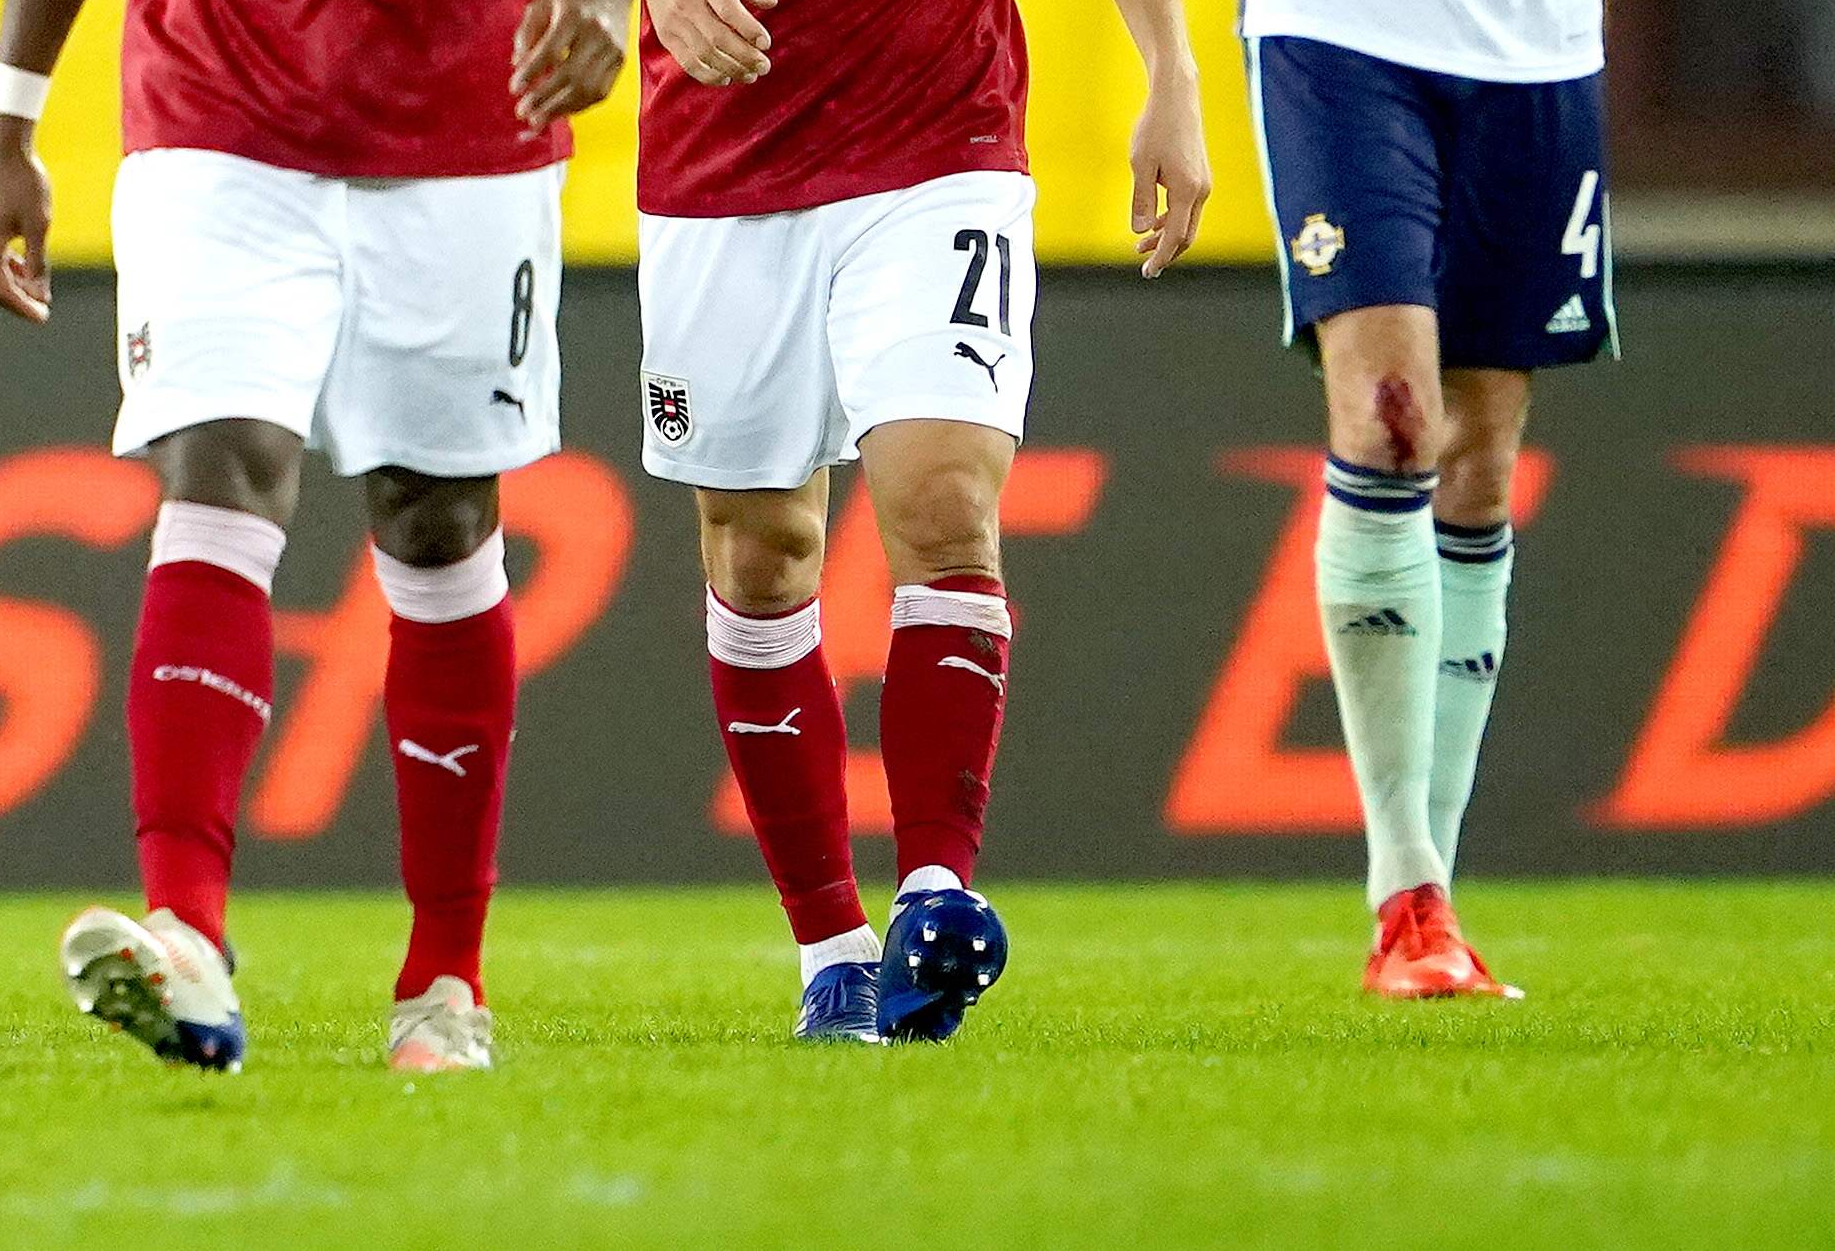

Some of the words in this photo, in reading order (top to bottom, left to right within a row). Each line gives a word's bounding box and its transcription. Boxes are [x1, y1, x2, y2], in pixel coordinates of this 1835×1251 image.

[1561, 169, 1601, 278] 4
[509, 258, 534, 368] 8
[949, 227, 1013, 337] 21
